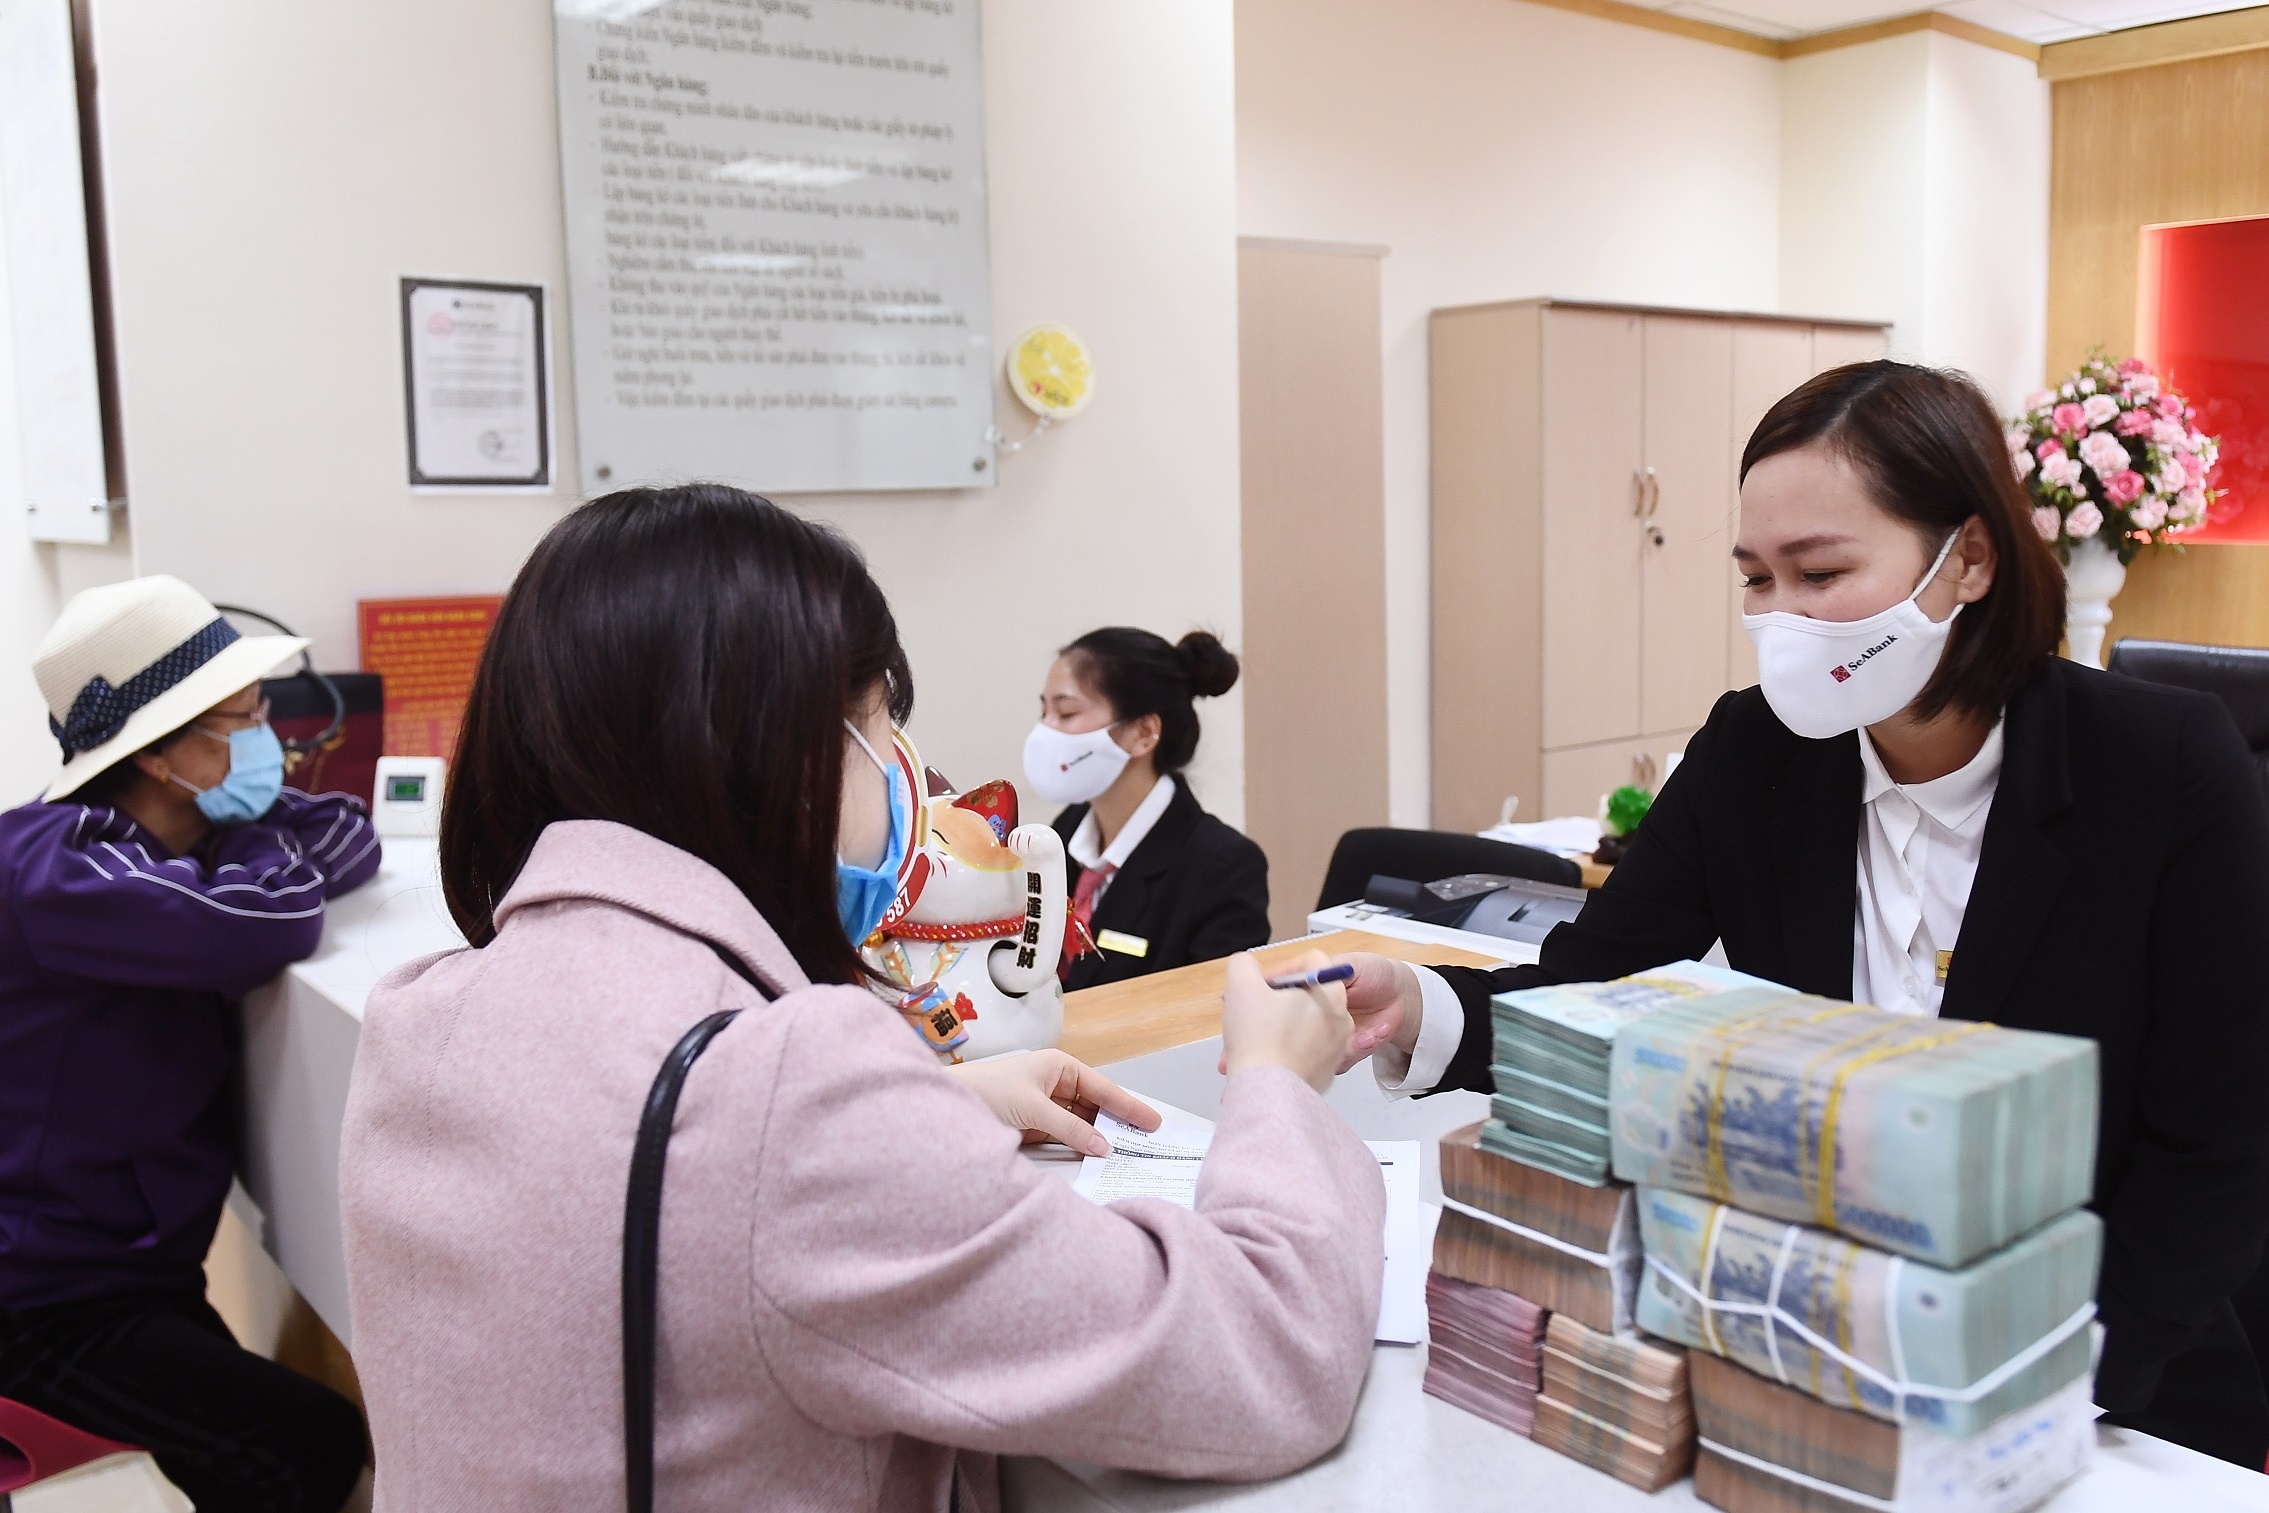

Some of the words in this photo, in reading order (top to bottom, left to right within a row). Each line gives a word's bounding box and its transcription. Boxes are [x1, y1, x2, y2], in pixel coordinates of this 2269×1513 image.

[1848, 634, 1898, 671] SeABank
[1016, 871, 1042, 970] 開運招財
[1115, 1121, 1149, 1139] SeABank
